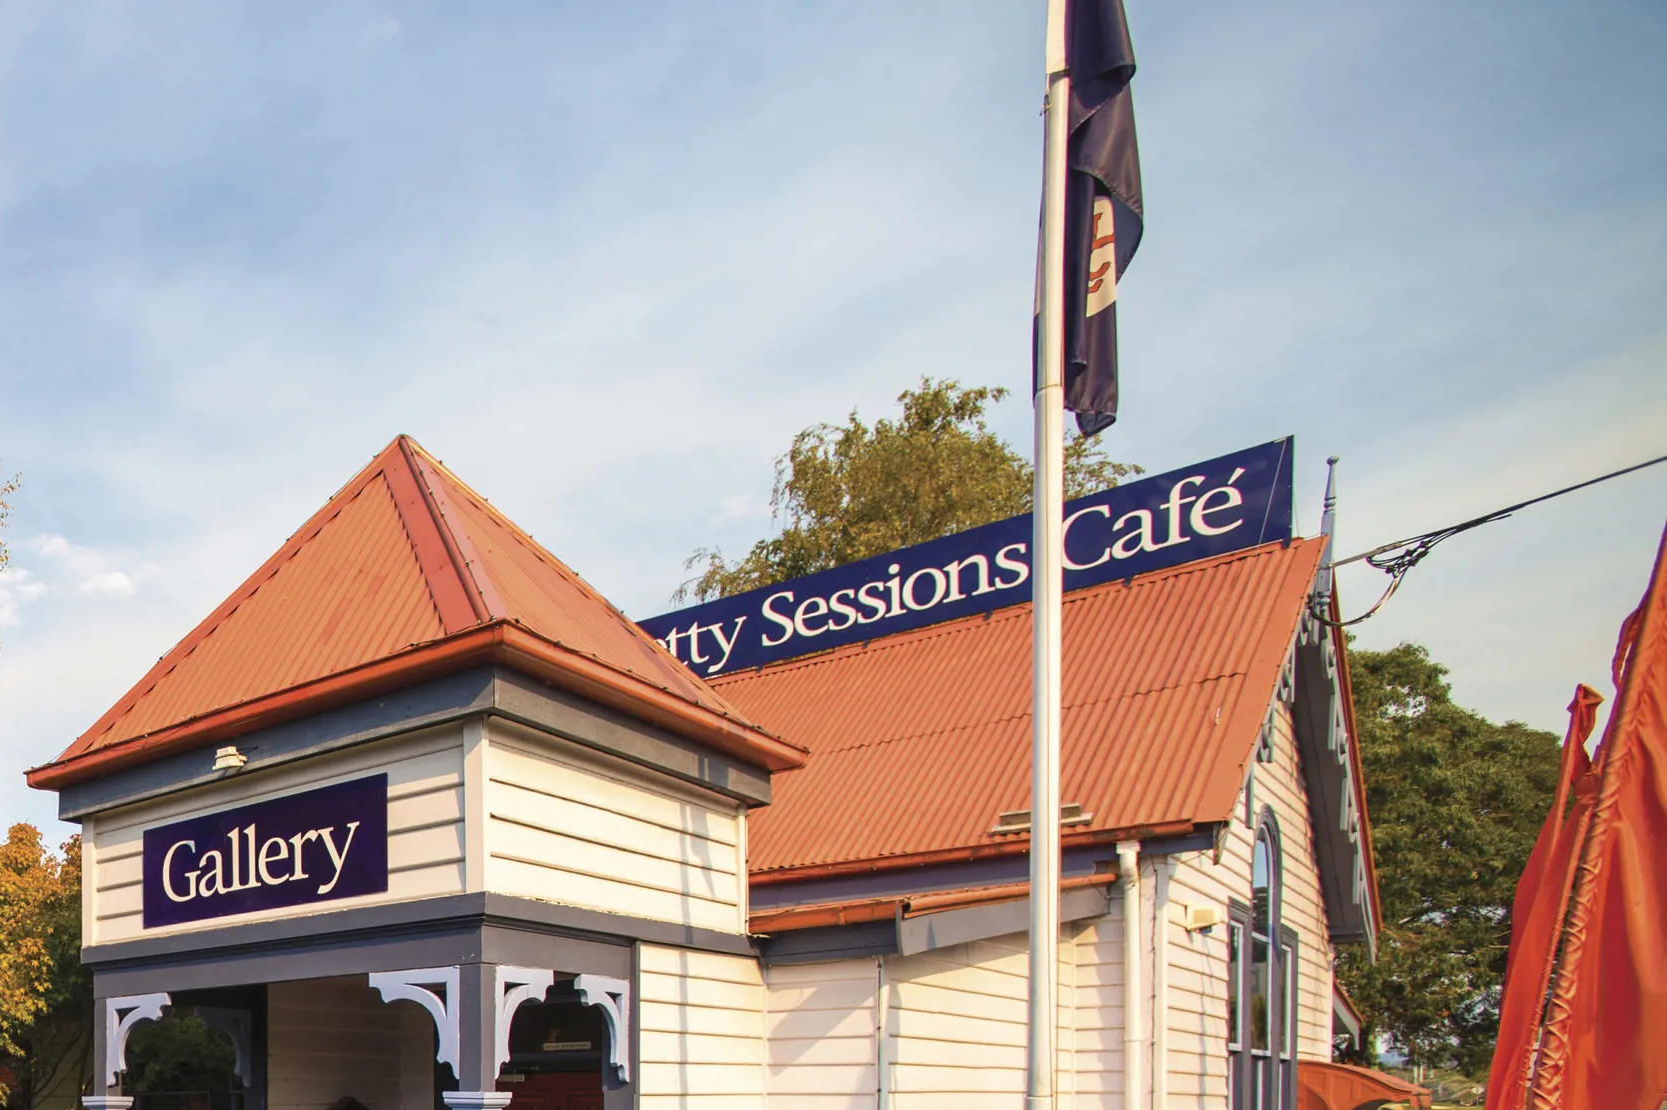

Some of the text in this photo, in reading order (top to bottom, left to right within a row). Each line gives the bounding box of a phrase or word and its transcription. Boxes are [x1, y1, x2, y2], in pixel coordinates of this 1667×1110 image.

[761, 542, 1030, 647] Sessions
[1062, 466, 1246, 571] Café
[162, 821, 360, 903] Gallery
